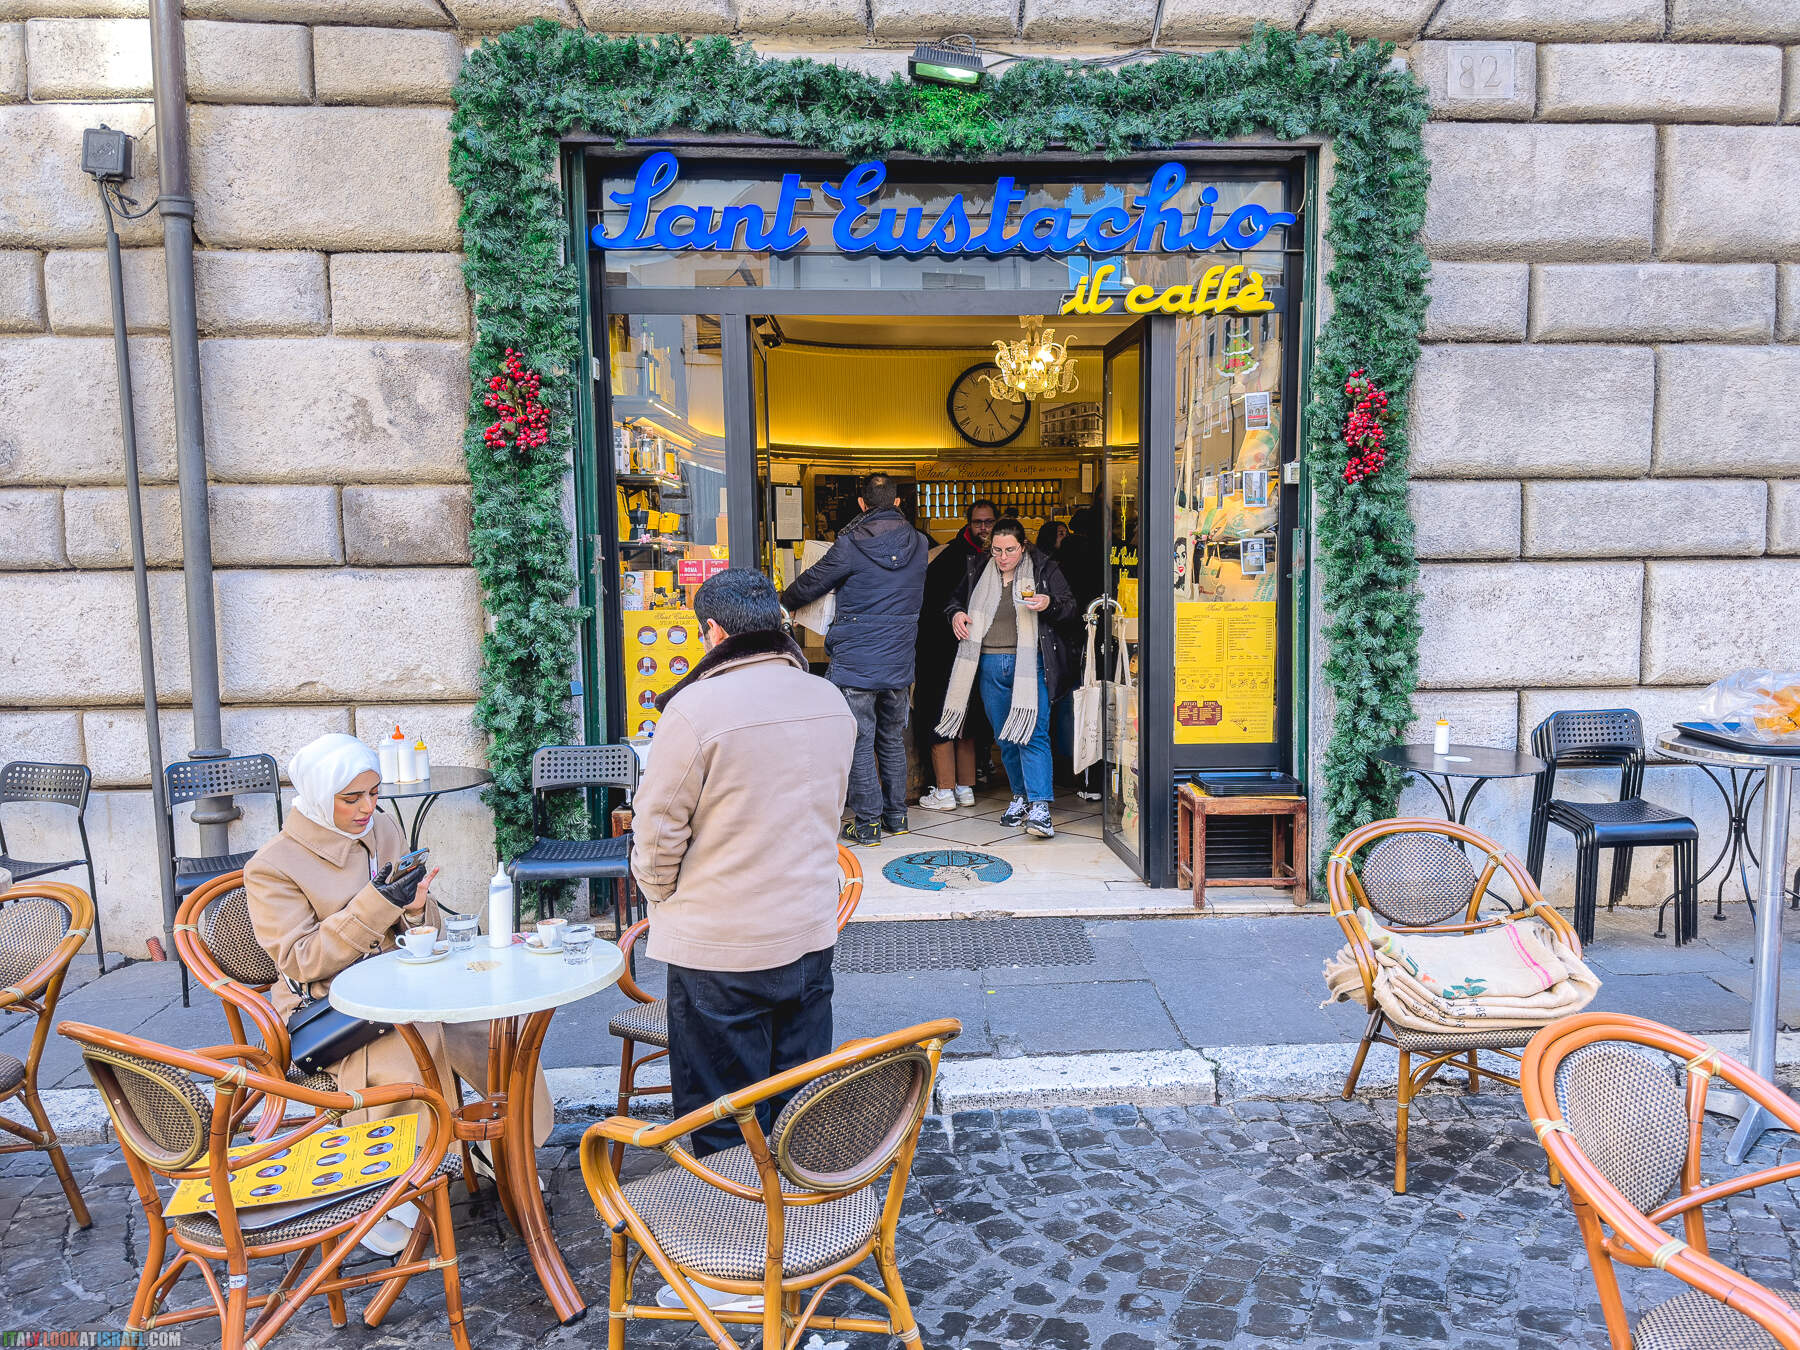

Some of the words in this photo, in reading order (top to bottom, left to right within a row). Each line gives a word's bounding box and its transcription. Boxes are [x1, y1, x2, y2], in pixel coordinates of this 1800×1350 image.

[1459, 55, 1503, 89] 82
[591, 151, 813, 254] Sant
[821, 160, 1297, 254] Eustachio
[1061, 265, 1114, 315] il
[1124, 264, 1275, 316] caffè
